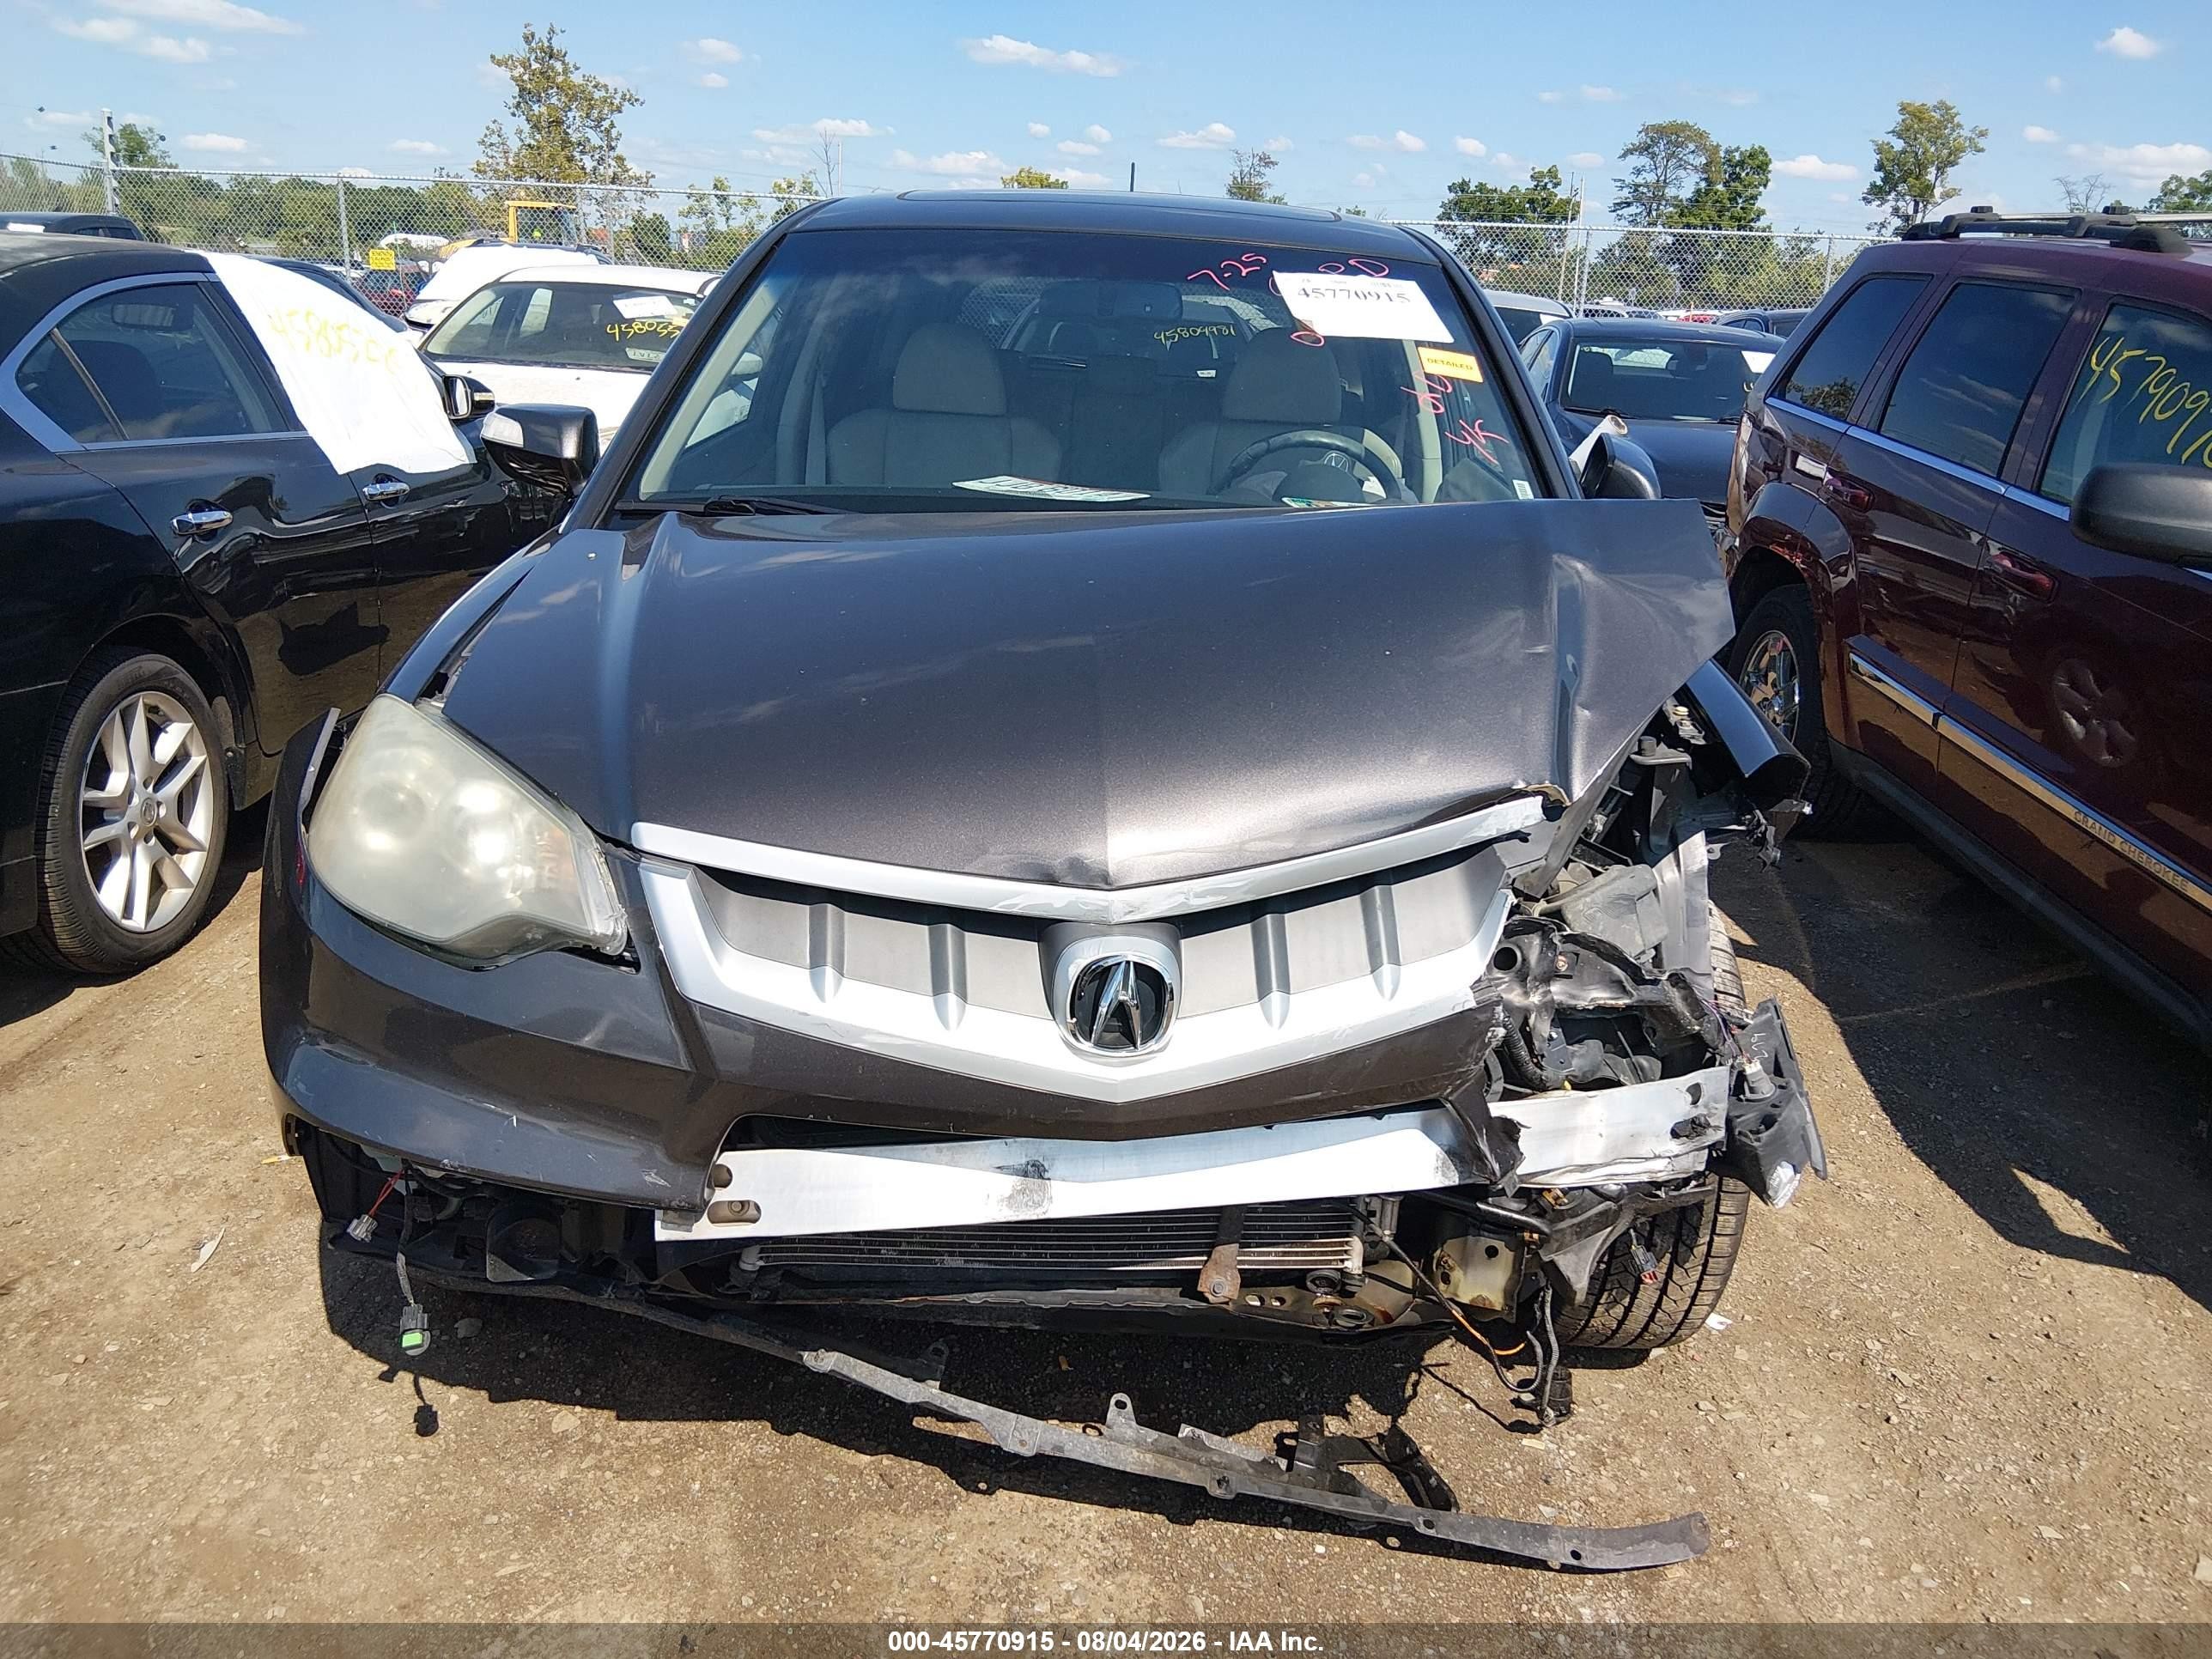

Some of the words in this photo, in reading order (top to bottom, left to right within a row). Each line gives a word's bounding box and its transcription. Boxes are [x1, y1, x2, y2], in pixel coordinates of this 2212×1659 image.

[1297, 287, 1411, 303] 45770915
[1426, 357, 1474, 371] DETAILED
[2074, 811, 2117, 843] GRAND
[2119, 840, 2190, 892] CHEROKEE
